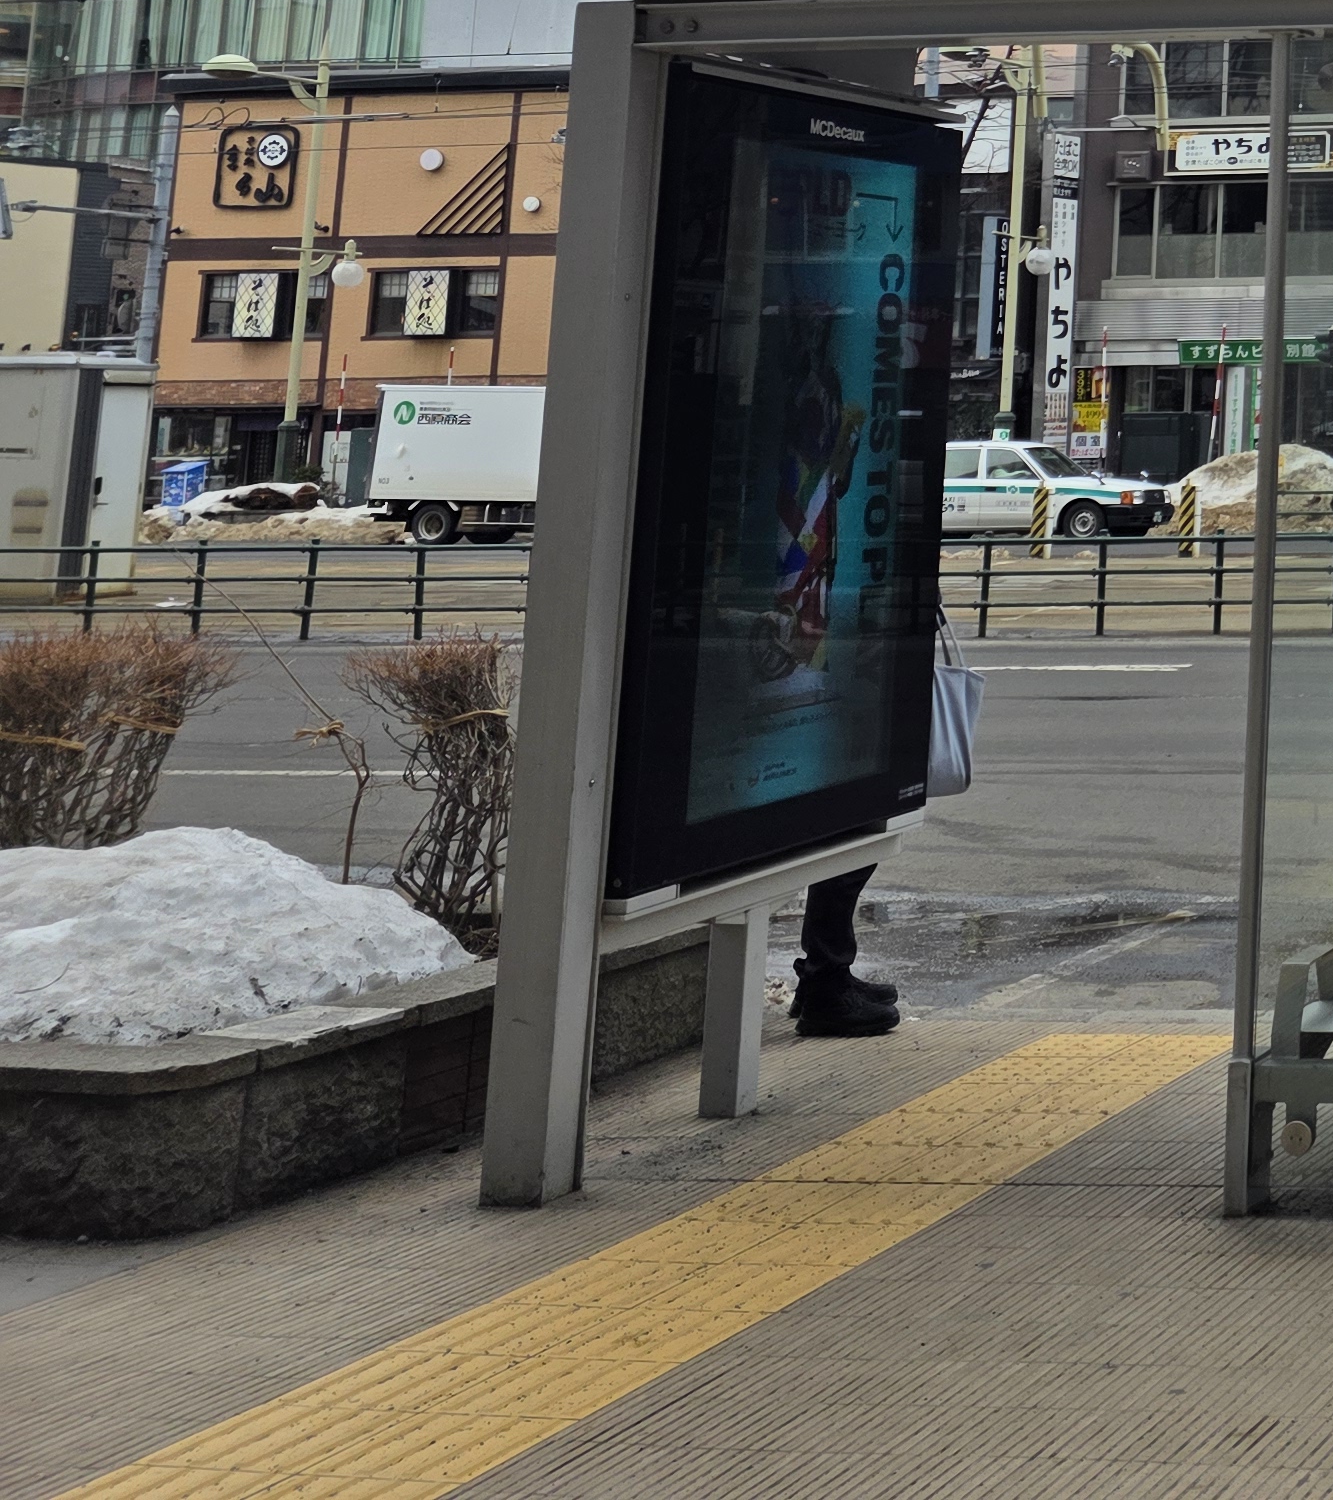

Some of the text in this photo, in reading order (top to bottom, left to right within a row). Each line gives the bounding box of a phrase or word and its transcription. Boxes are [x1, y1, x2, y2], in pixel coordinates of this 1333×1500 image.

[809, 118, 865, 143] MCDecaux
[996, 221, 1009, 335] OSTERIA
[1047, 256, 1072, 388] やちよ
[869, 253, 905, 454] COMES
[1189, 343, 1316, 359] すずらんビ別館
[864, 461, 892, 538] TO
